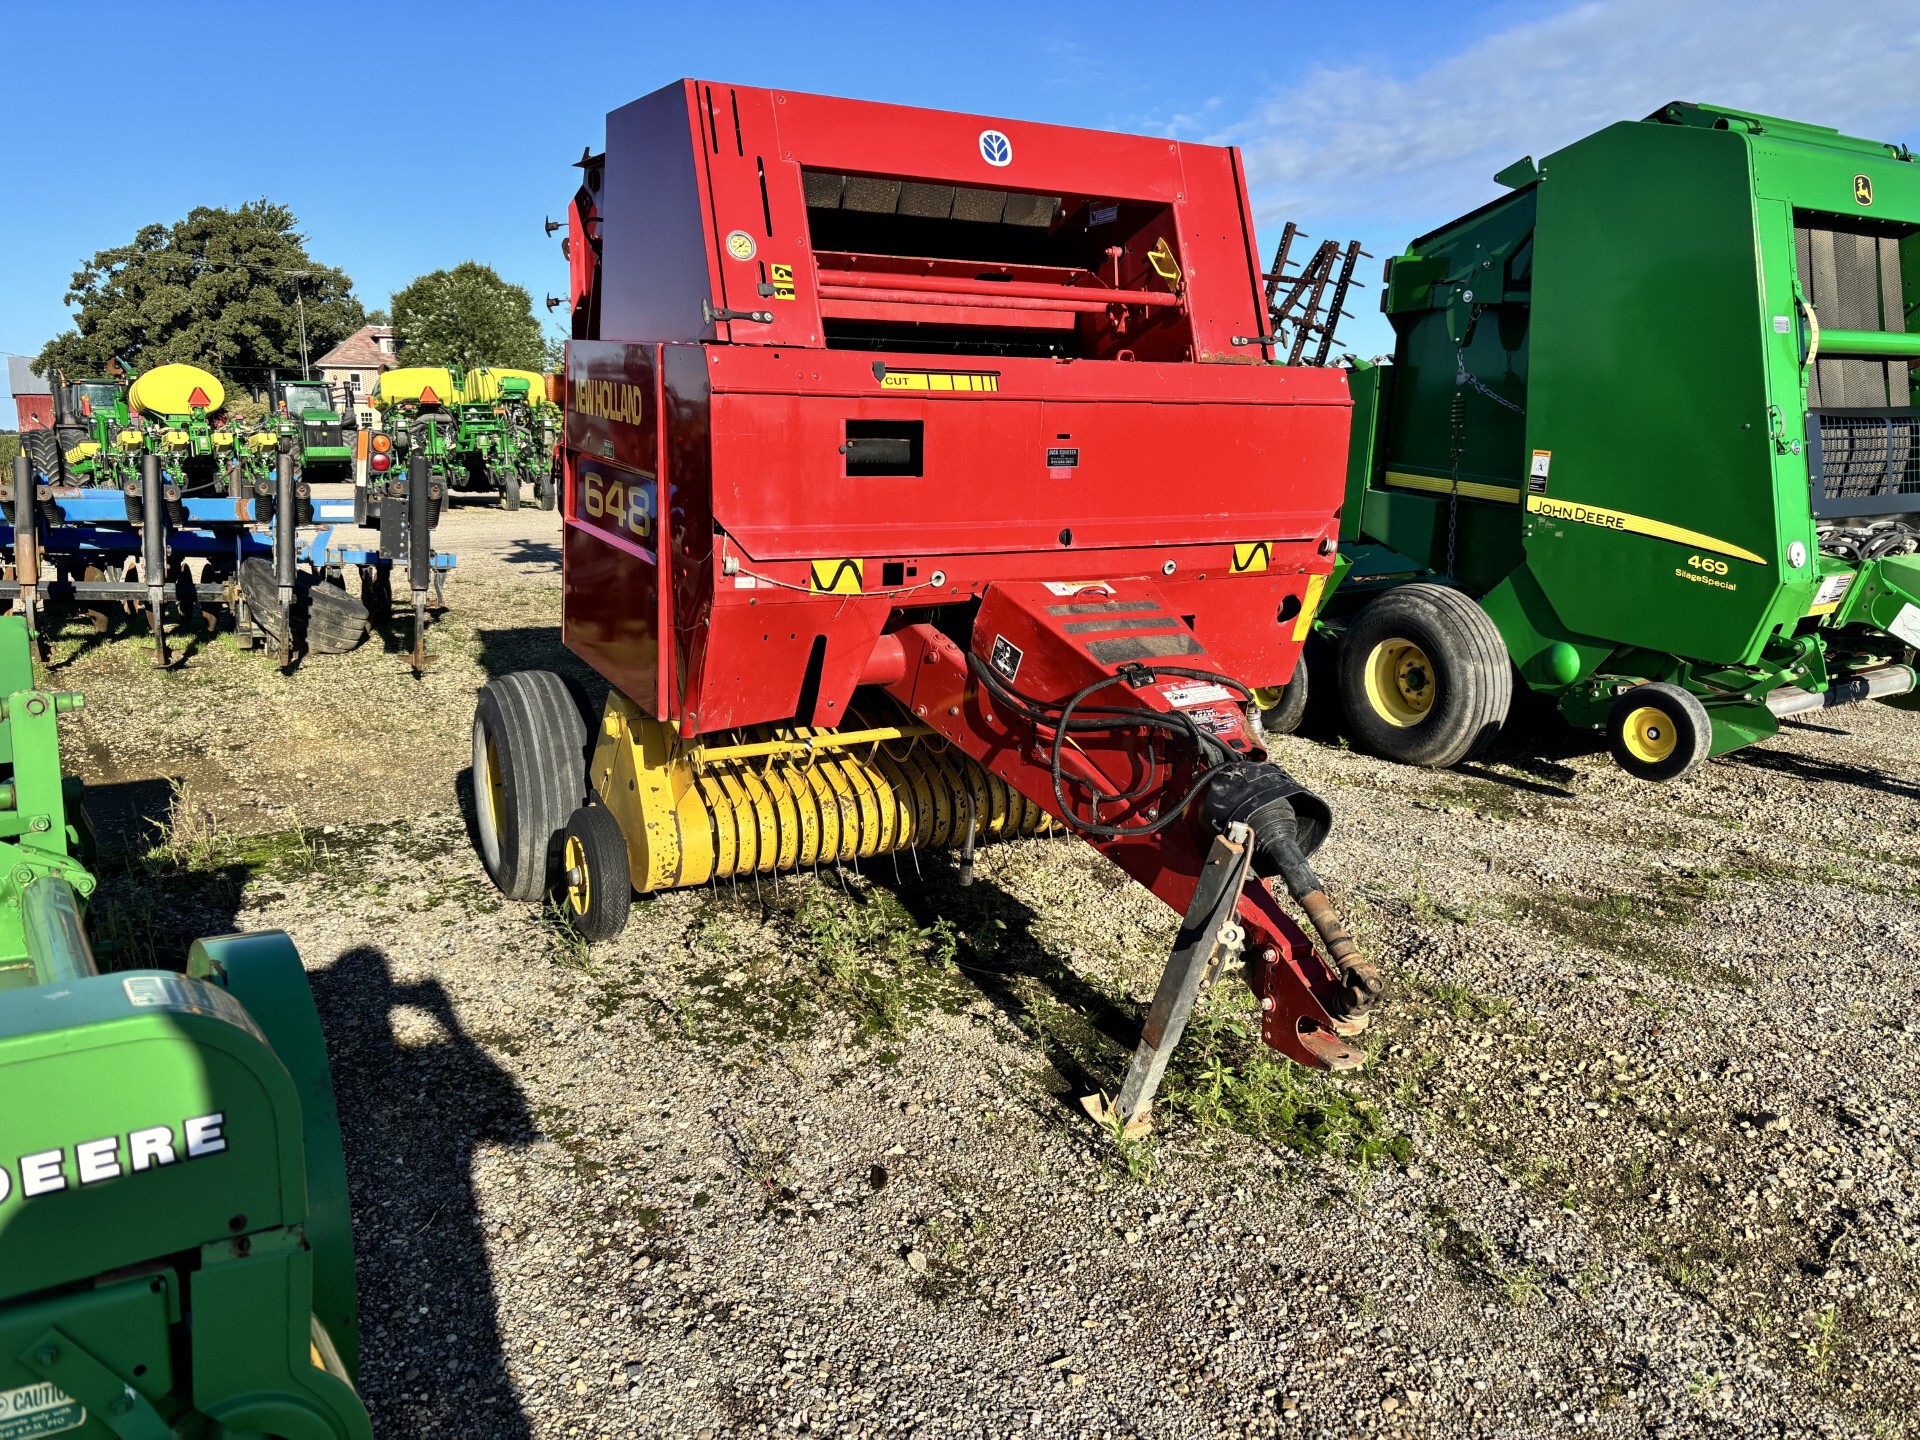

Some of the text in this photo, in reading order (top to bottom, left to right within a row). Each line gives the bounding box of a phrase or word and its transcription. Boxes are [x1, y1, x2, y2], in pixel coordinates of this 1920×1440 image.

[885, 377, 909, 386] CUT
[575, 378, 642, 426] NEW HOLLAND
[585, 471, 650, 537] 648
[1534, 501, 1625, 528] JOHN DEERE
[1687, 555, 1729, 576] 469
[1675, 568, 1736, 591] SilageSpecial
[13, 1387, 66, 1411] CAUTIO
